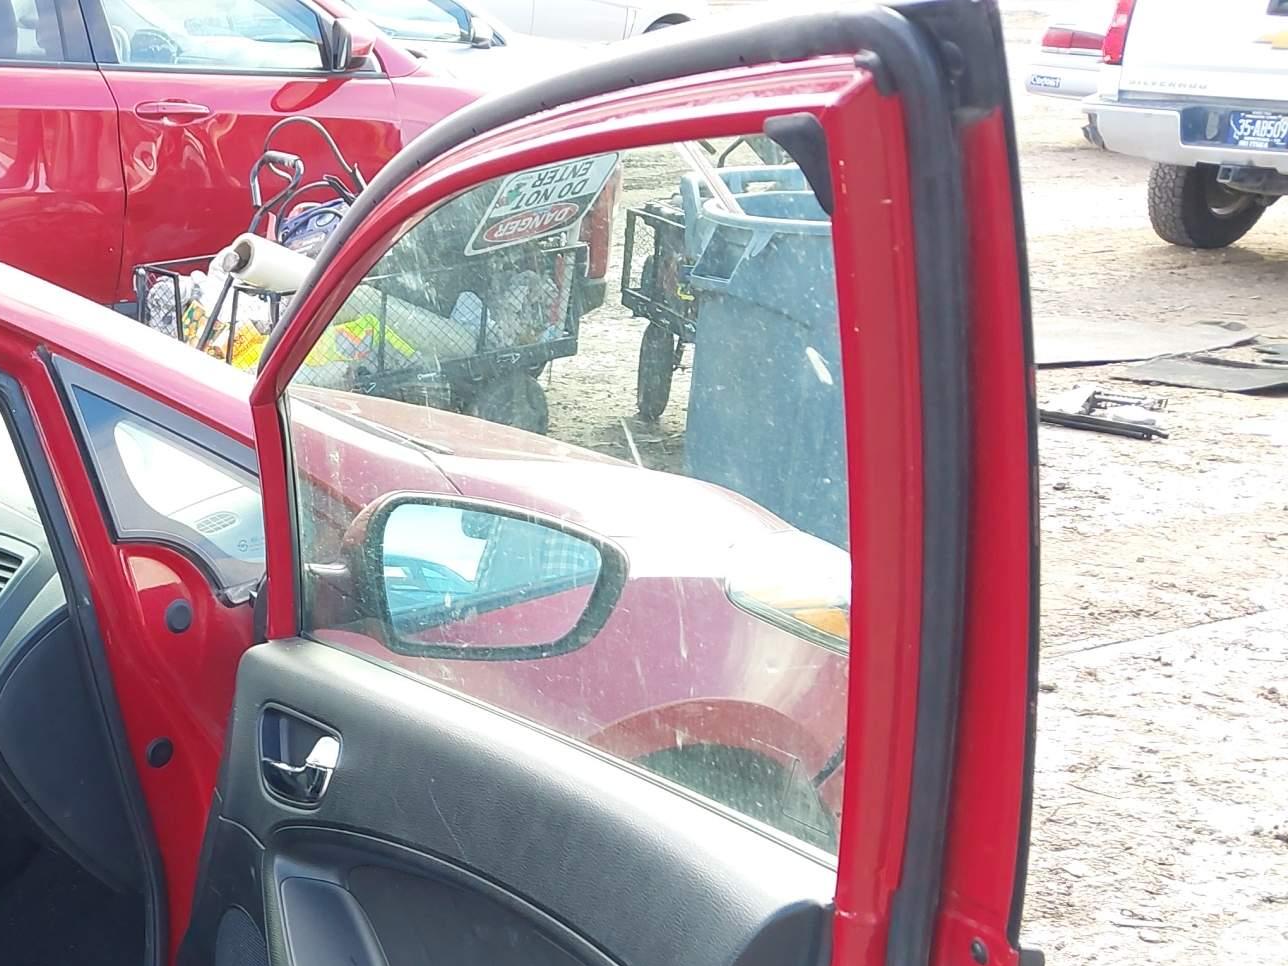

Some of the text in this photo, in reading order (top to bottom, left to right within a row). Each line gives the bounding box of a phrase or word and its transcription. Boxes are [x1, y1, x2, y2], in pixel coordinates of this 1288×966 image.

[531, 161, 594, 188] ENTER
[511, 179, 589, 210] DO NOT
[494, 208, 569, 238] DANGER
